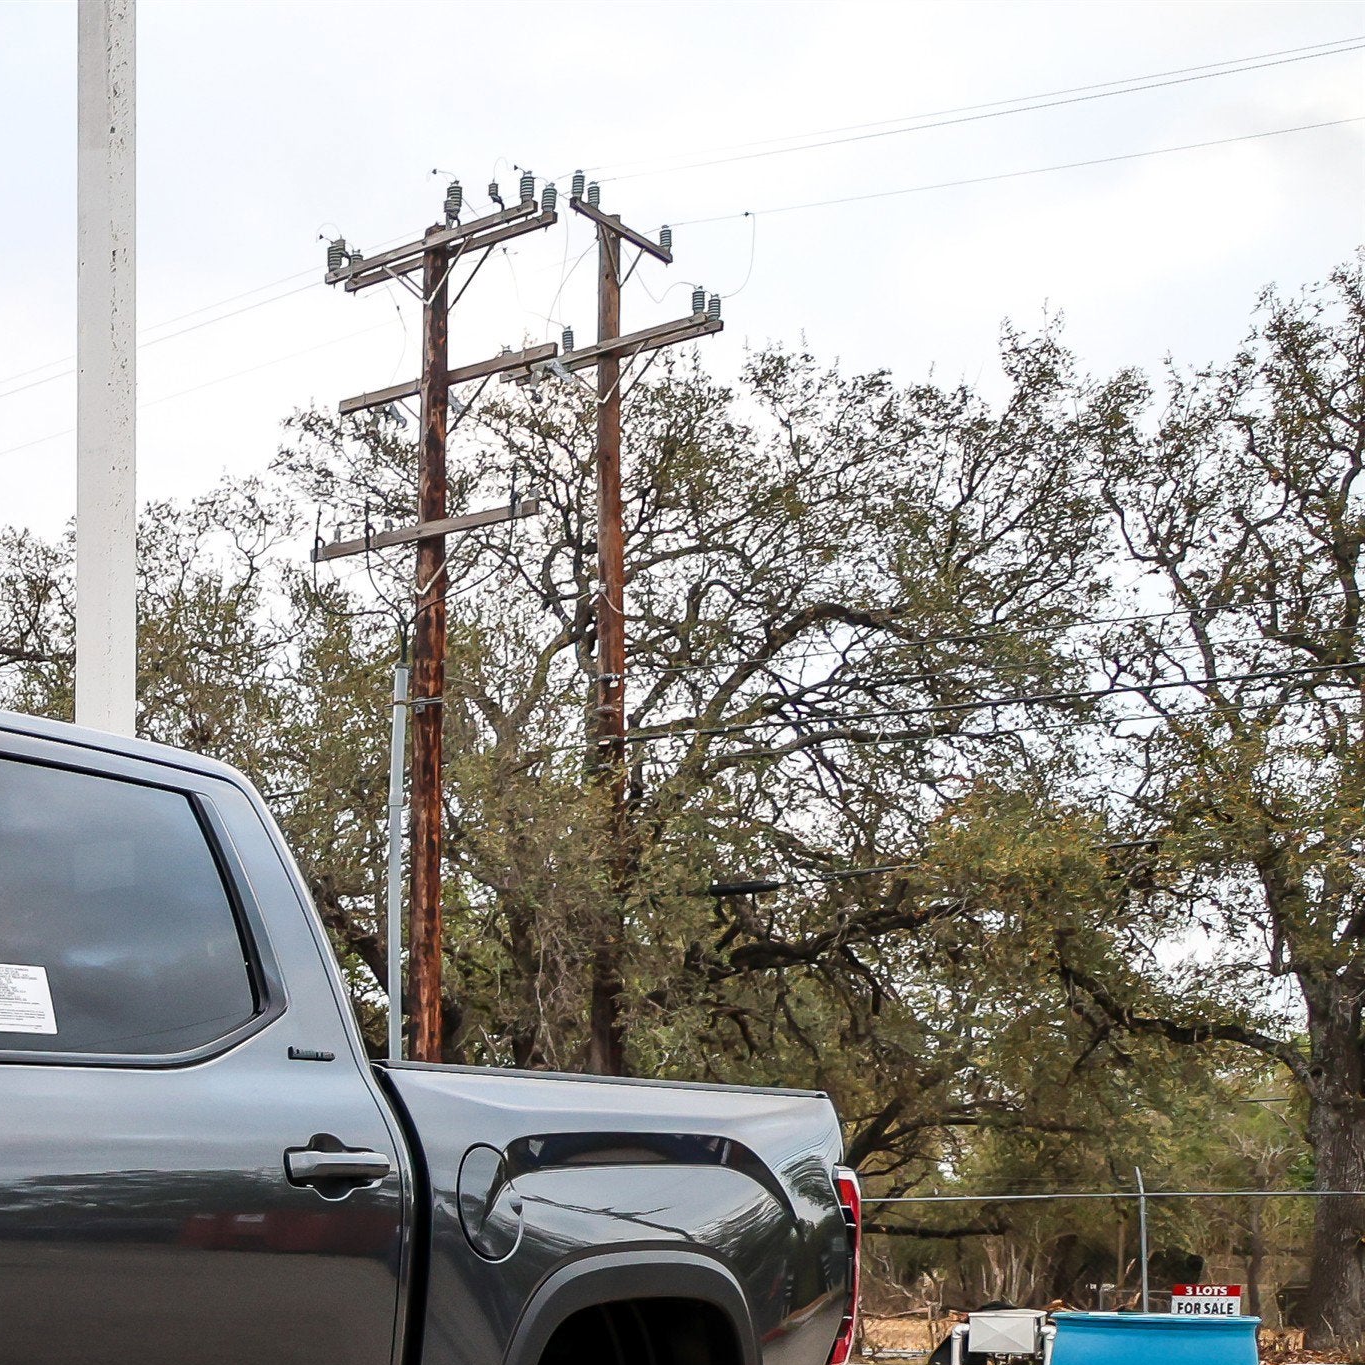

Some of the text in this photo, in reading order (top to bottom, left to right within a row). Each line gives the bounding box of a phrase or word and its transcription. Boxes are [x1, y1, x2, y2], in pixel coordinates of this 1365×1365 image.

[1185, 1286, 1228, 1296] 3 LOTS
[1177, 1302, 1234, 1315] FOR SALE
